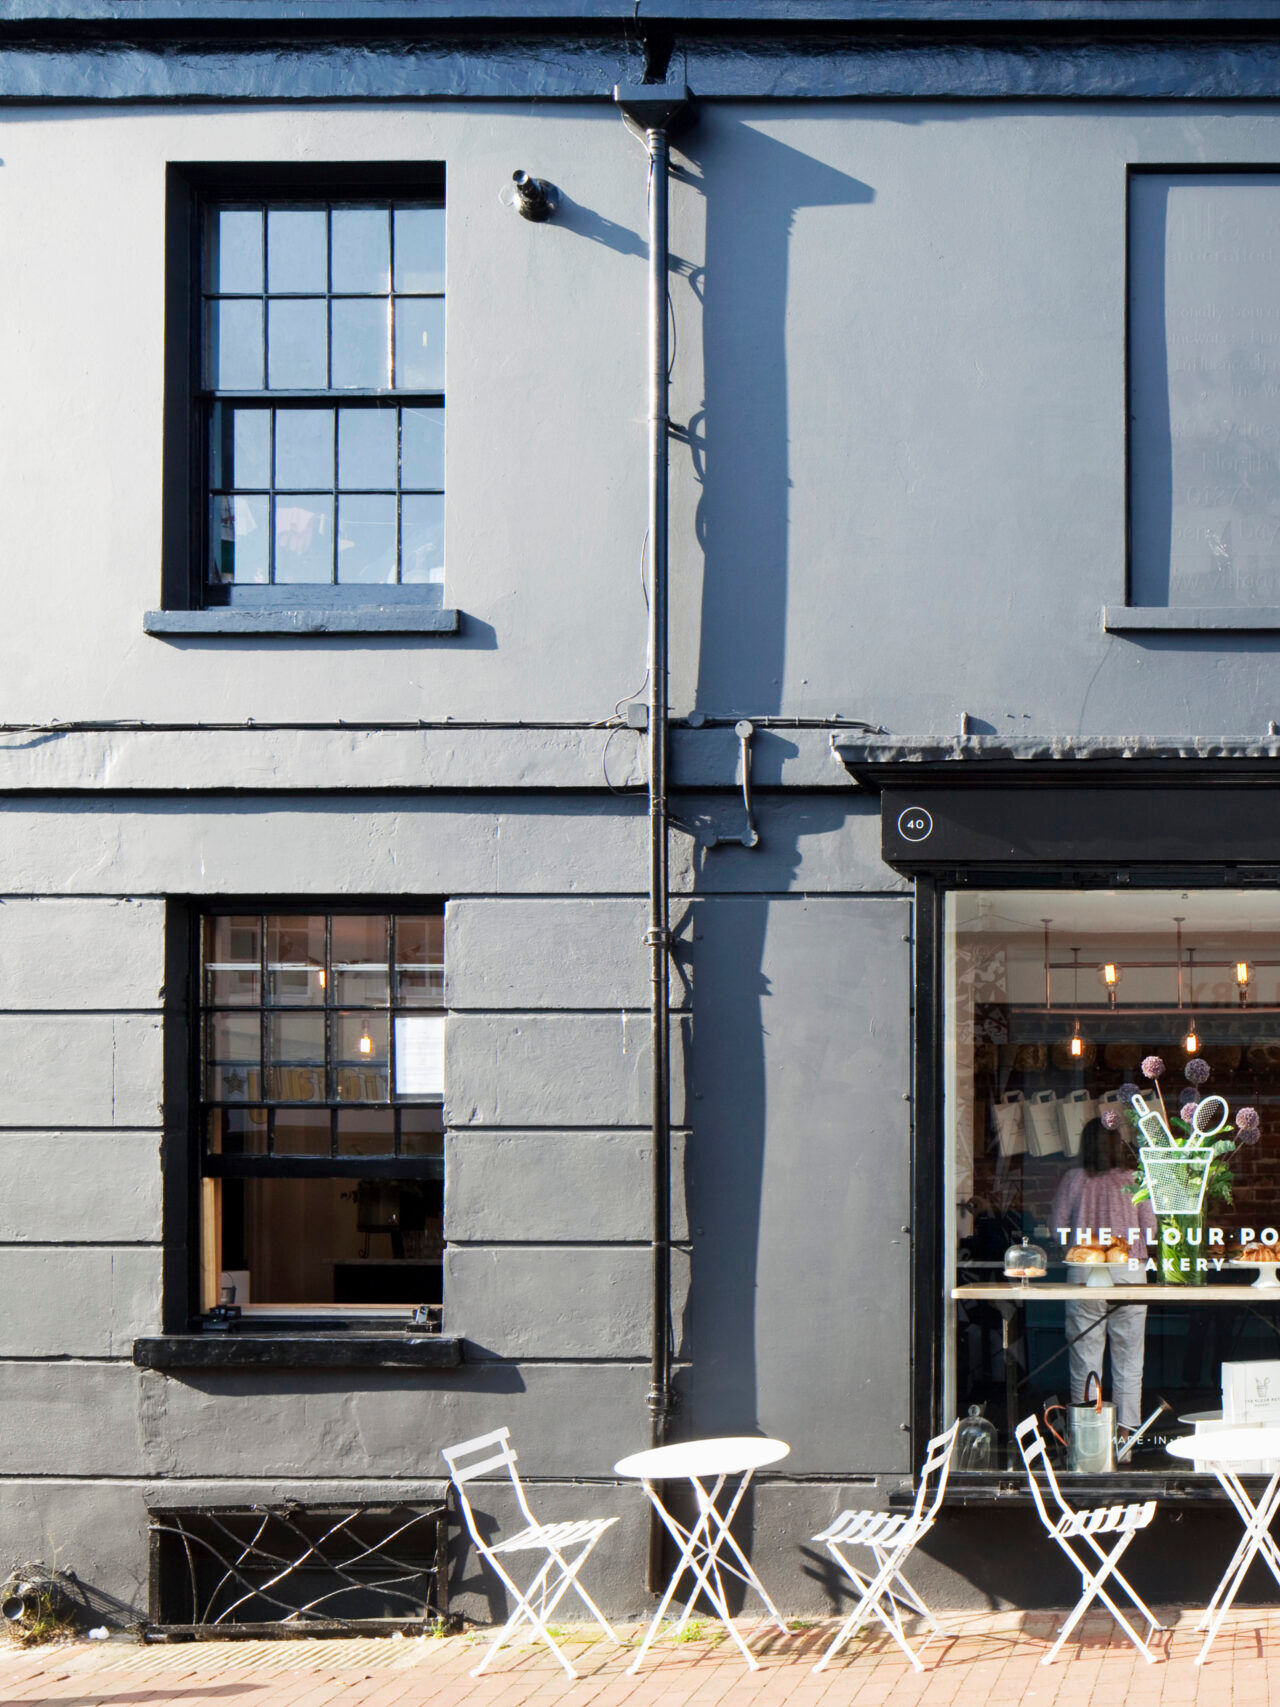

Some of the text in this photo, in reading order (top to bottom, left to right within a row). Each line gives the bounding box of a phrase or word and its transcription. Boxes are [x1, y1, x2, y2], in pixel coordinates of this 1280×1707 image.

[906, 819, 924, 829] 40
[1056, 1227, 1113, 1246] THE
[1127, 1227, 1225, 1246] FLOUR
[1127, 1257, 1226, 1272] BAKERY
